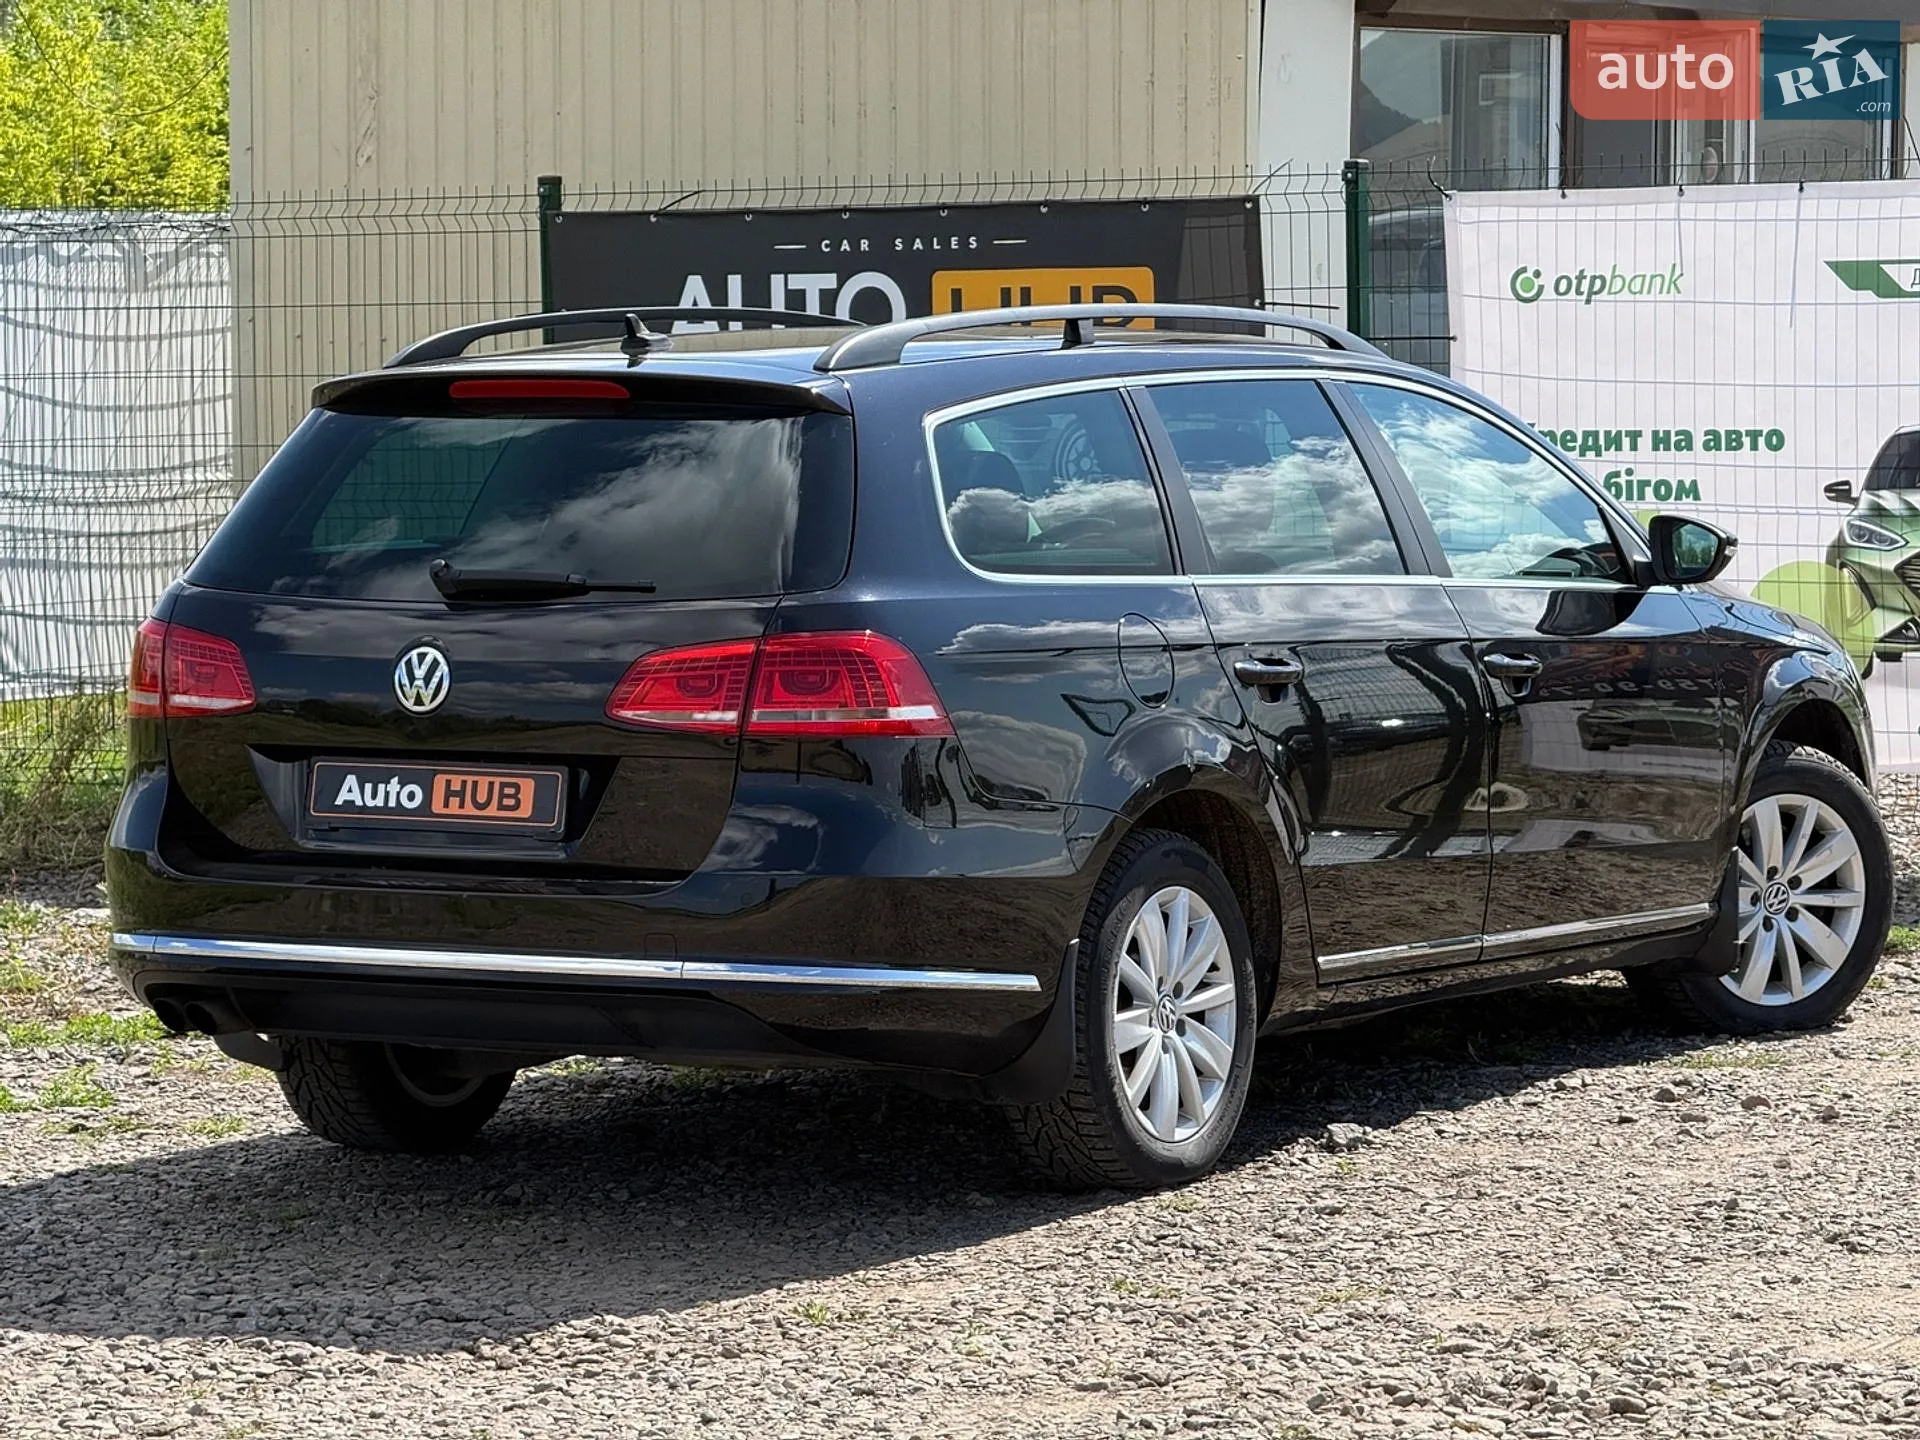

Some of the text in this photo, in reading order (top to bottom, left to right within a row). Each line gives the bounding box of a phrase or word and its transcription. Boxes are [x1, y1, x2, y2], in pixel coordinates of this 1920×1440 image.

[820, 236, 978, 252] CAR SALES
[1553, 263, 1685, 305] otpbank
[1527, 423, 1786, 457] редит на авто
[334, 774, 522, 812] Auto HUB
